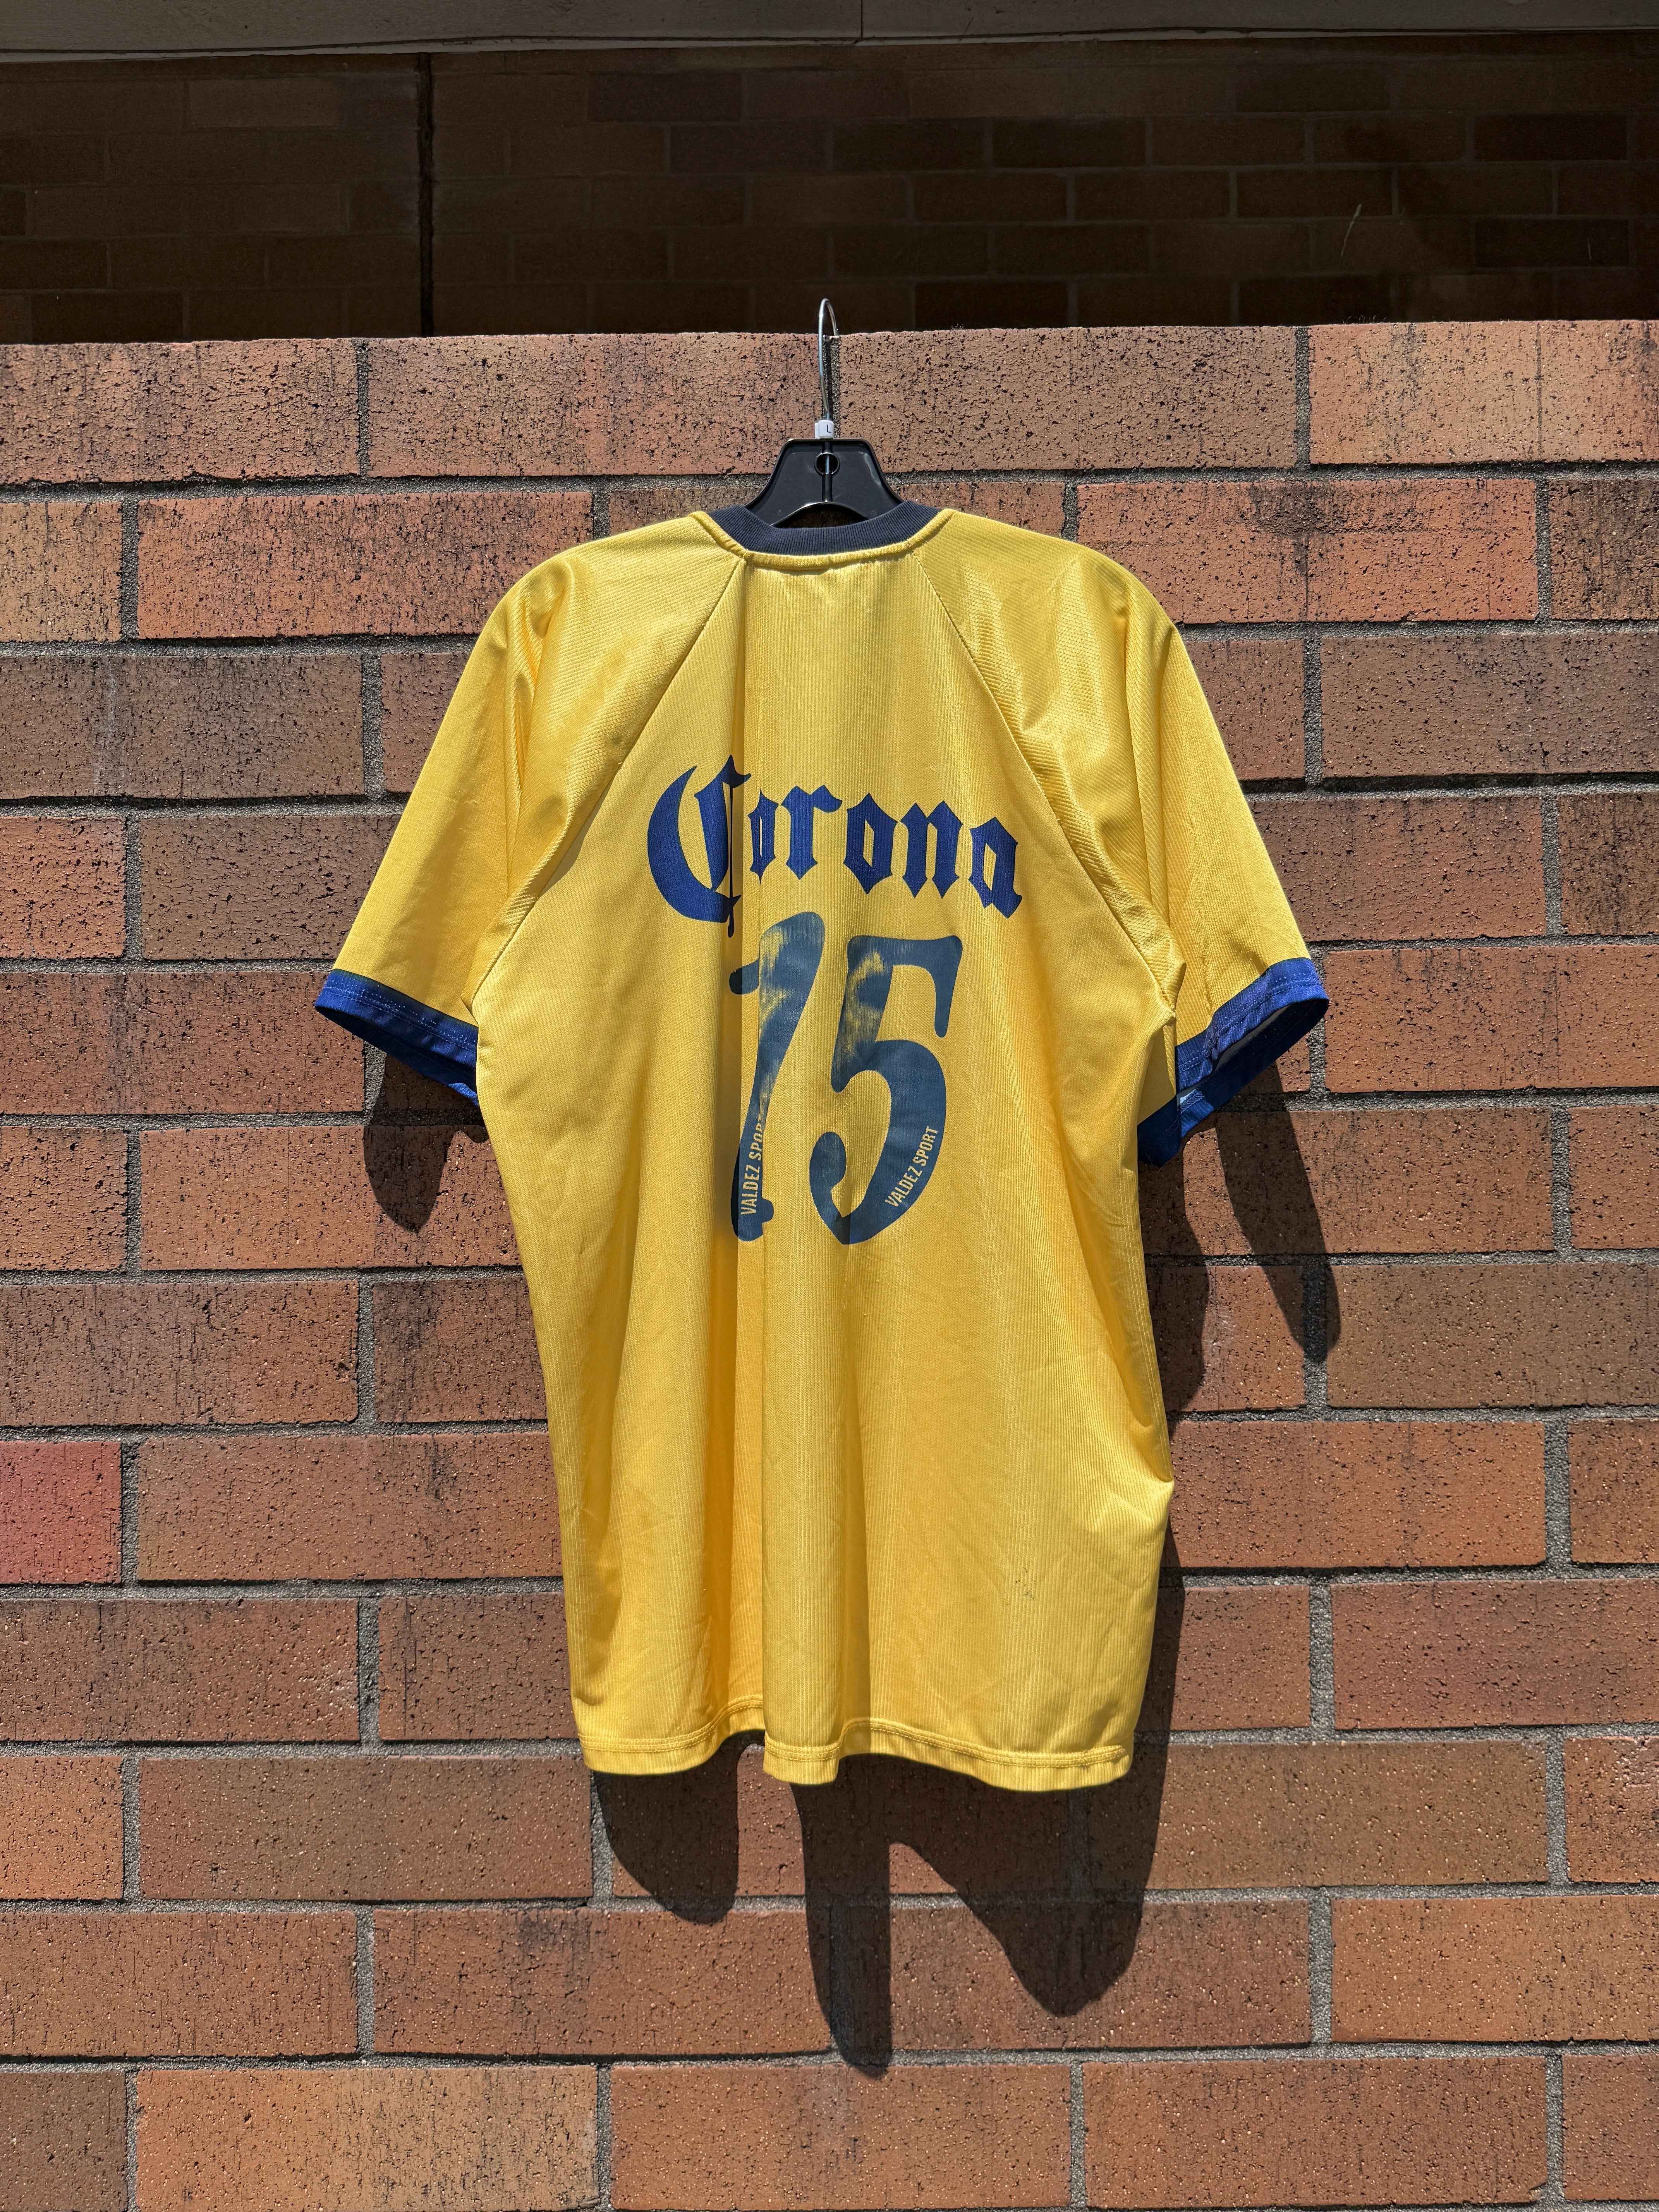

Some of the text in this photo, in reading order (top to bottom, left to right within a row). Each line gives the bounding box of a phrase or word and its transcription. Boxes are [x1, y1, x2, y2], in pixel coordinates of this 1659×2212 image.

[827, 424, 831, 433] L
[647, 755, 1022, 938] Corona
[740, 1164, 760, 1215] VALDEZ
[885, 1126, 938, 1207] VALDEZ SPORT
